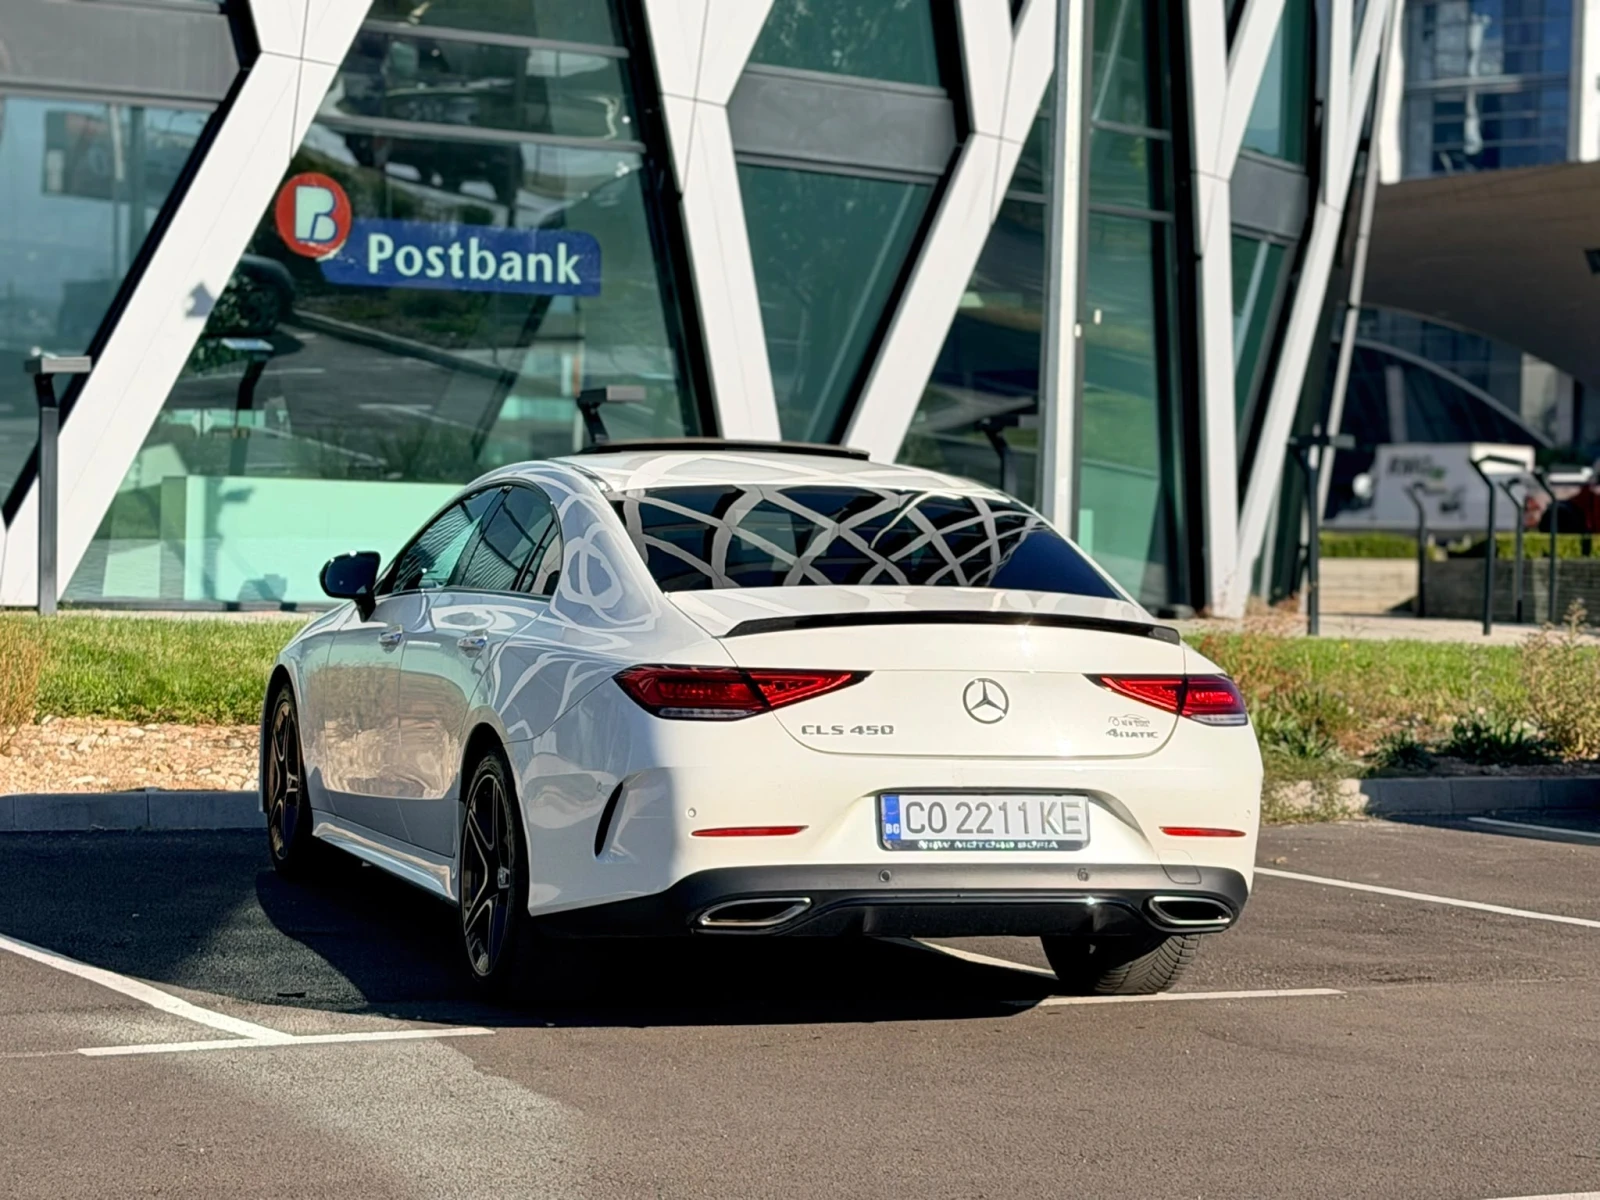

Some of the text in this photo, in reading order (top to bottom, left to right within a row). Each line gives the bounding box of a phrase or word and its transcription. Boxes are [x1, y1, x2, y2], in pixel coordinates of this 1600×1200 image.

[367, 232, 582, 285] Postbank
[801, 724, 894, 736] CLS 450
[905, 801, 1083, 834] CO 2211 KE
[885, 823, 900, 835] BG
